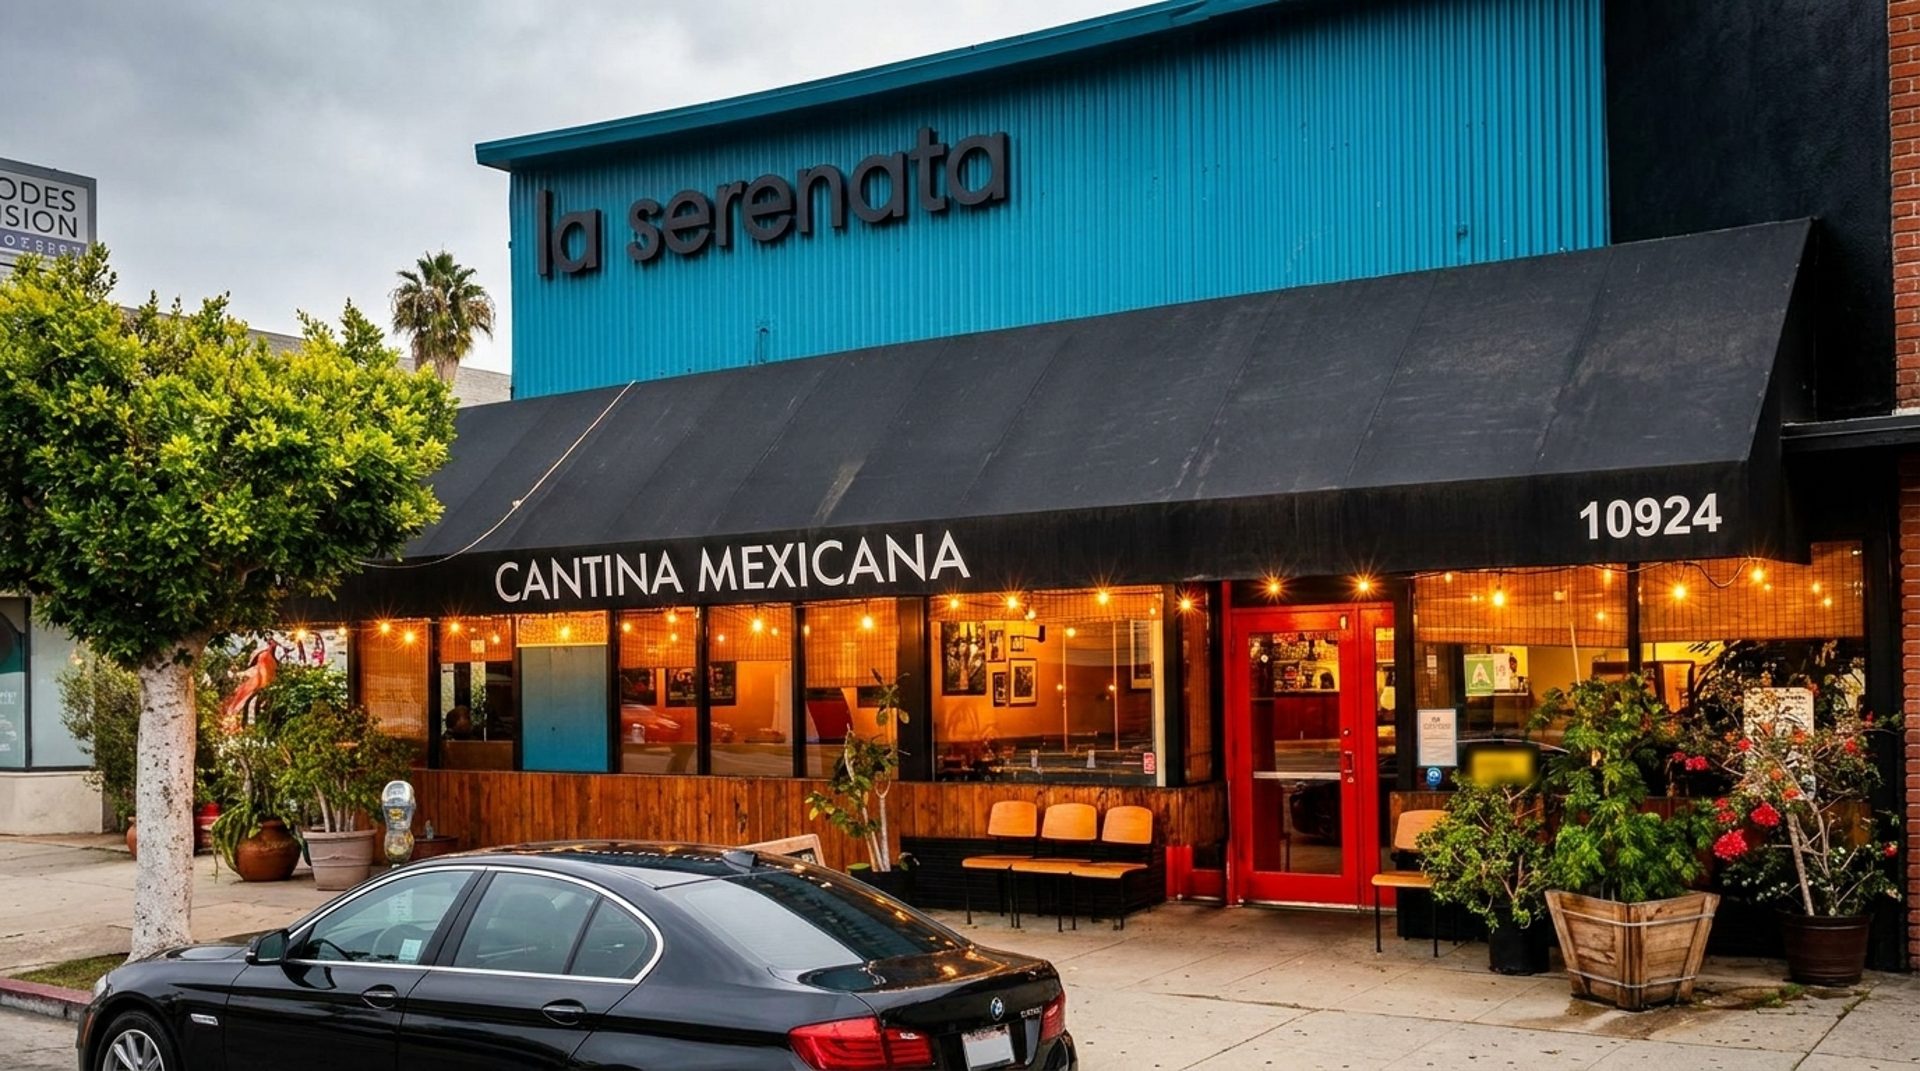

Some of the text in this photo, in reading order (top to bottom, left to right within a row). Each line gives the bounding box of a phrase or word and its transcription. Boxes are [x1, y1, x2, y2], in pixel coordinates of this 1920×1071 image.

[0, 177, 76, 213] ODES
[537, 127, 1008, 276] la serenata
[1579, 493, 1723, 540] 10924
[495, 530, 971, 602] CANTINA MEXICANA
